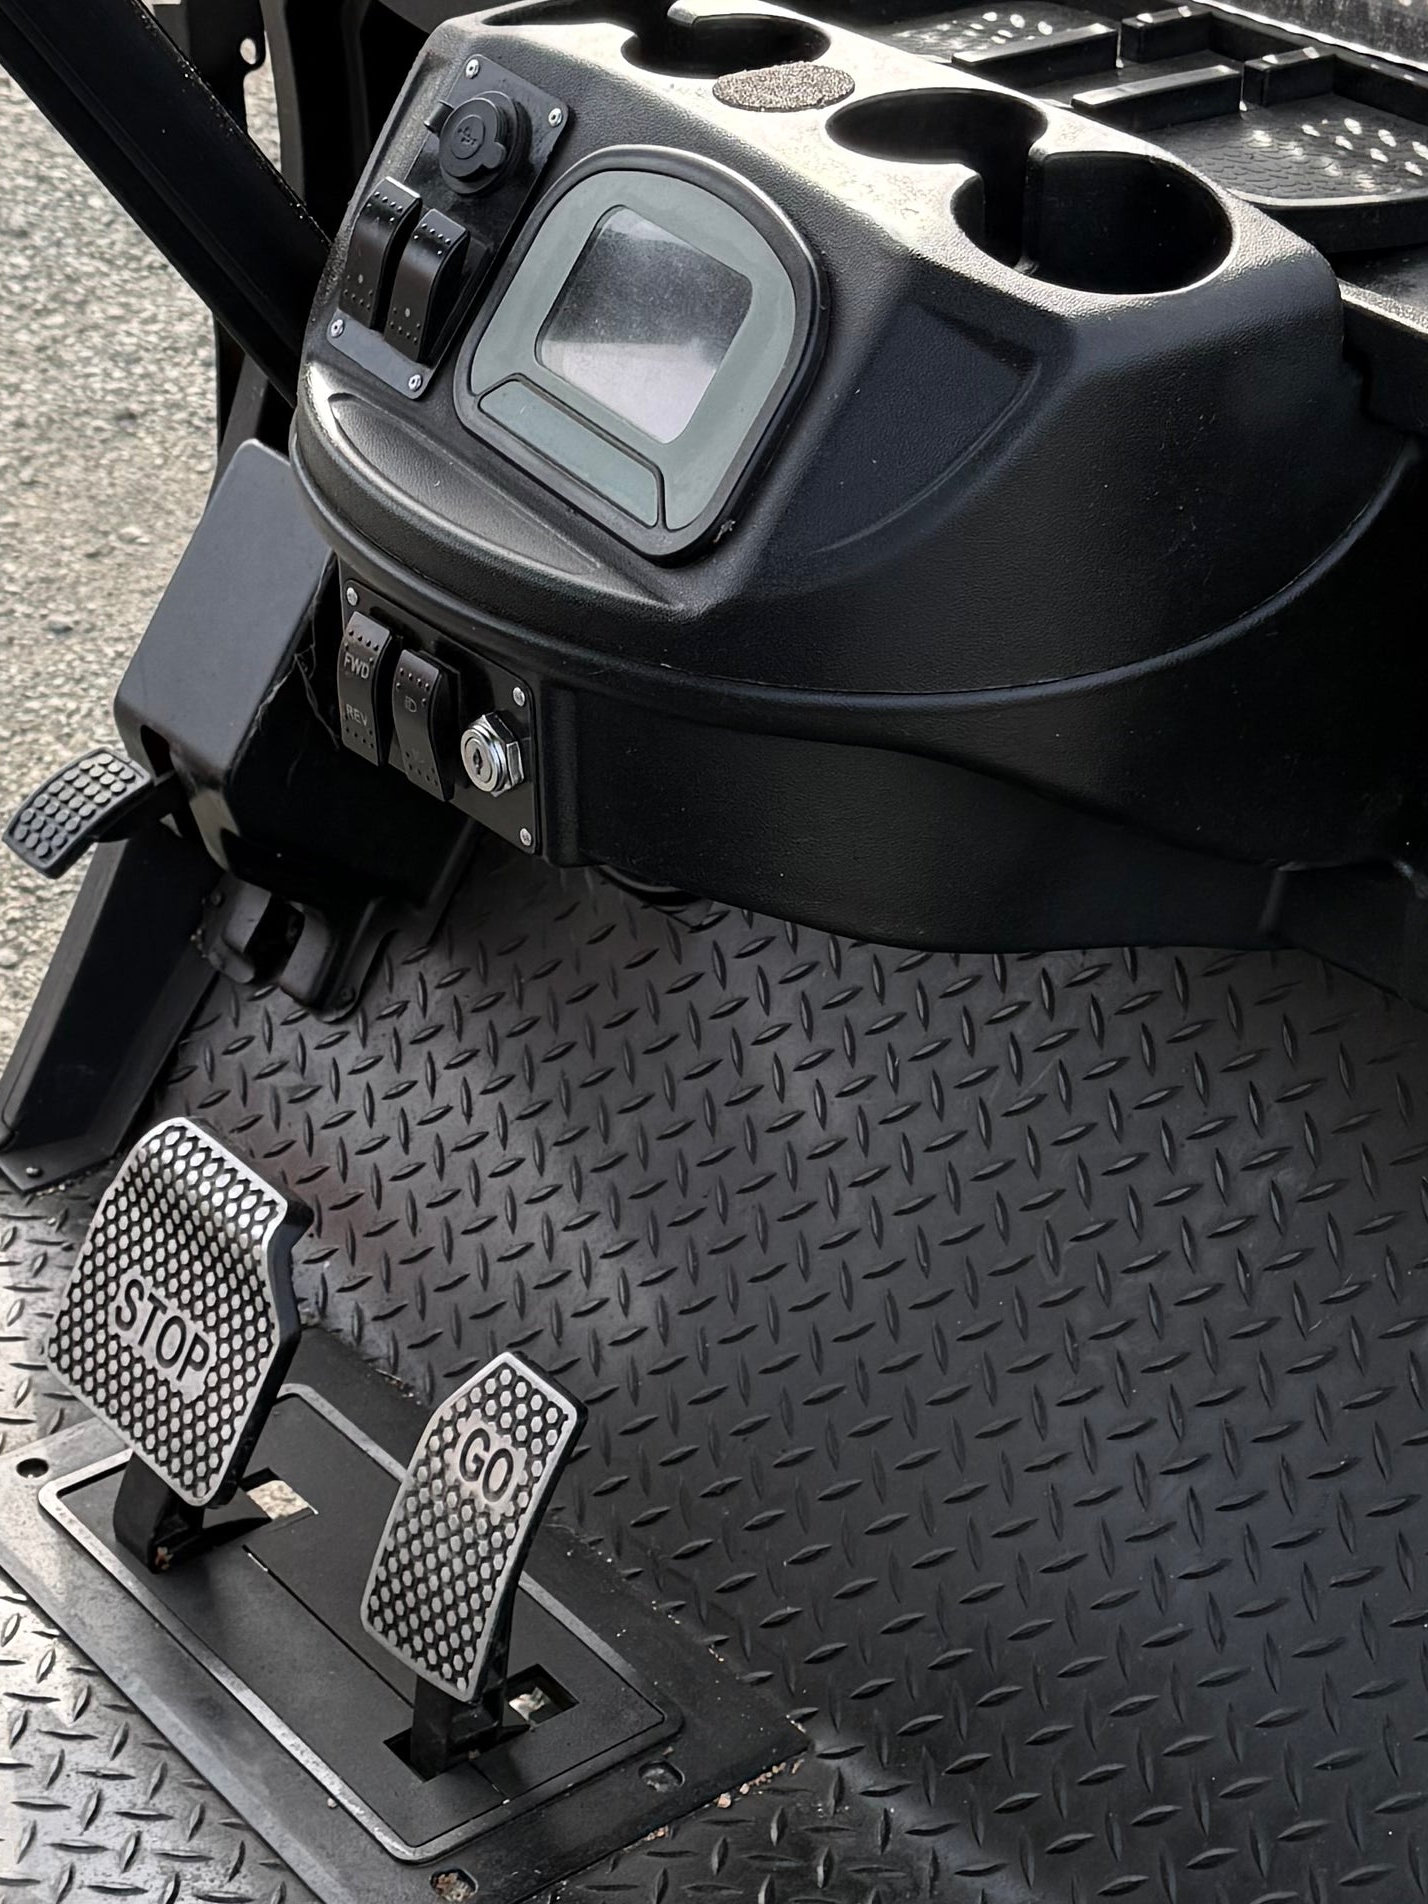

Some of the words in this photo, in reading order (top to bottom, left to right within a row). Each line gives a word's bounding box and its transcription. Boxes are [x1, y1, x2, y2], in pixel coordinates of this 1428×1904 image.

[343, 654, 370, 679] FWD
[345, 704, 368, 727] REV
[114, 1278, 210, 1381] STOP
[459, 1428, 514, 1503] GO
